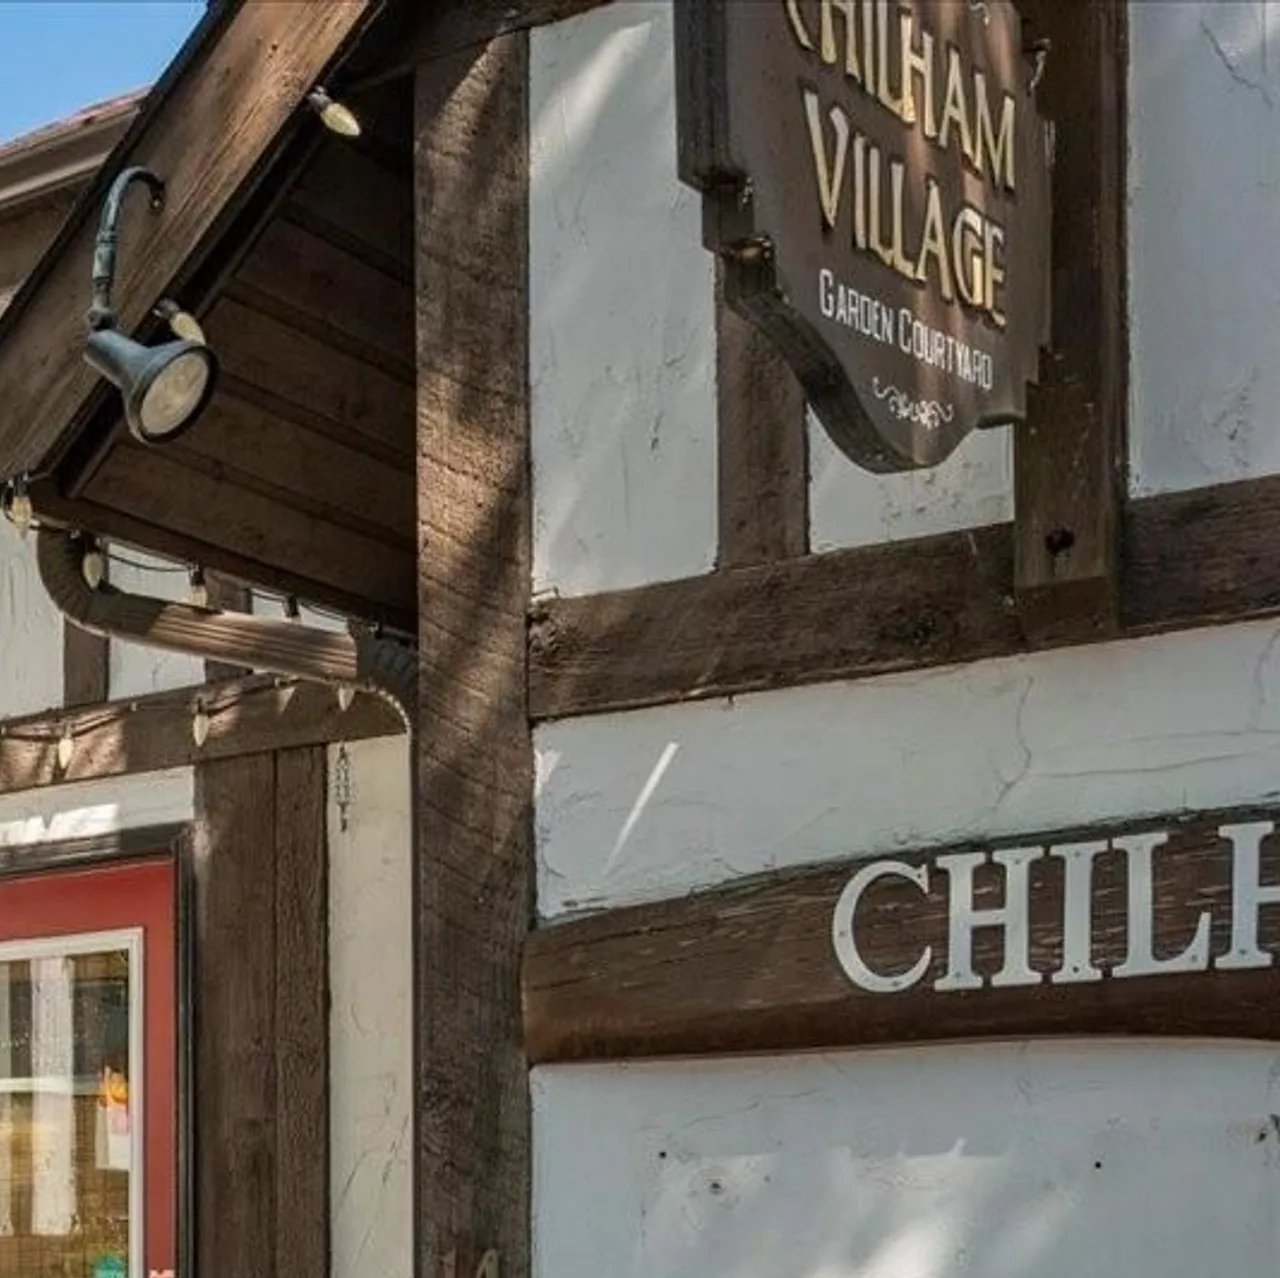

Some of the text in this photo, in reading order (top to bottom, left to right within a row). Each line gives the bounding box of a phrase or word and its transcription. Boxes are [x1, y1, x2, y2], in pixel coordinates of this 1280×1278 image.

[803, 88, 1007, 326] VILLAGE
[818, 268, 994, 391] GARDEN COURTYARD
